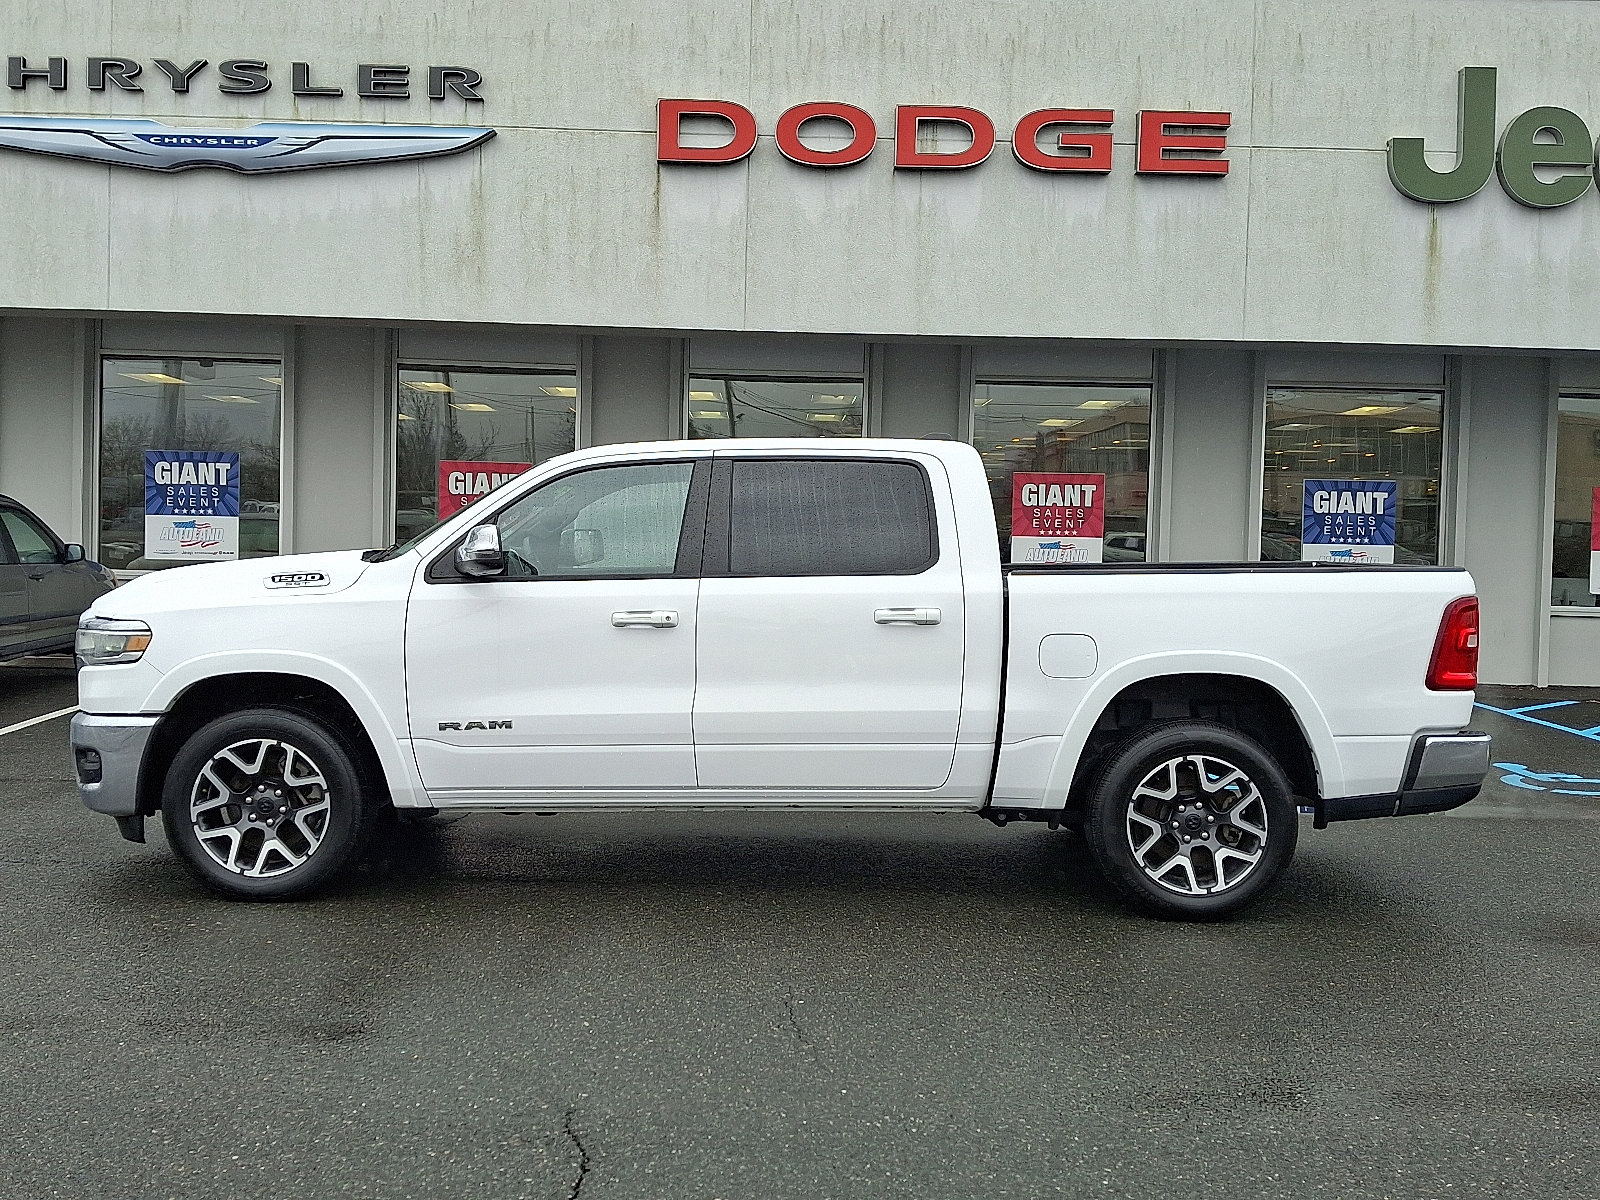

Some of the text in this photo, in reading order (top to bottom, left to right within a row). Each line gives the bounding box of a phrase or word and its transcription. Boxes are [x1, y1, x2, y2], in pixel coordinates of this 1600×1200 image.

[149, 136, 260, 146] CHRYSLER
[656, 97, 1232, 178] DODGE
[1386, 66, 1600, 209] Je
[154, 461, 232, 487] GIANT
[166, 486, 220, 497] SALES
[1021, 483, 1097, 508] GIANT
[166, 497, 221, 508] EVENT
[1313, 490, 1389, 515] GIANT
[1033, 508, 1084, 518] SALES
[1032, 518, 1085, 529] EVENT
[1324, 515, 1376, 526] SALES
[1323, 526, 1377, 537] EVENT
[272, 573, 322, 583] 1500
[438, 720, 513, 731] RAM
